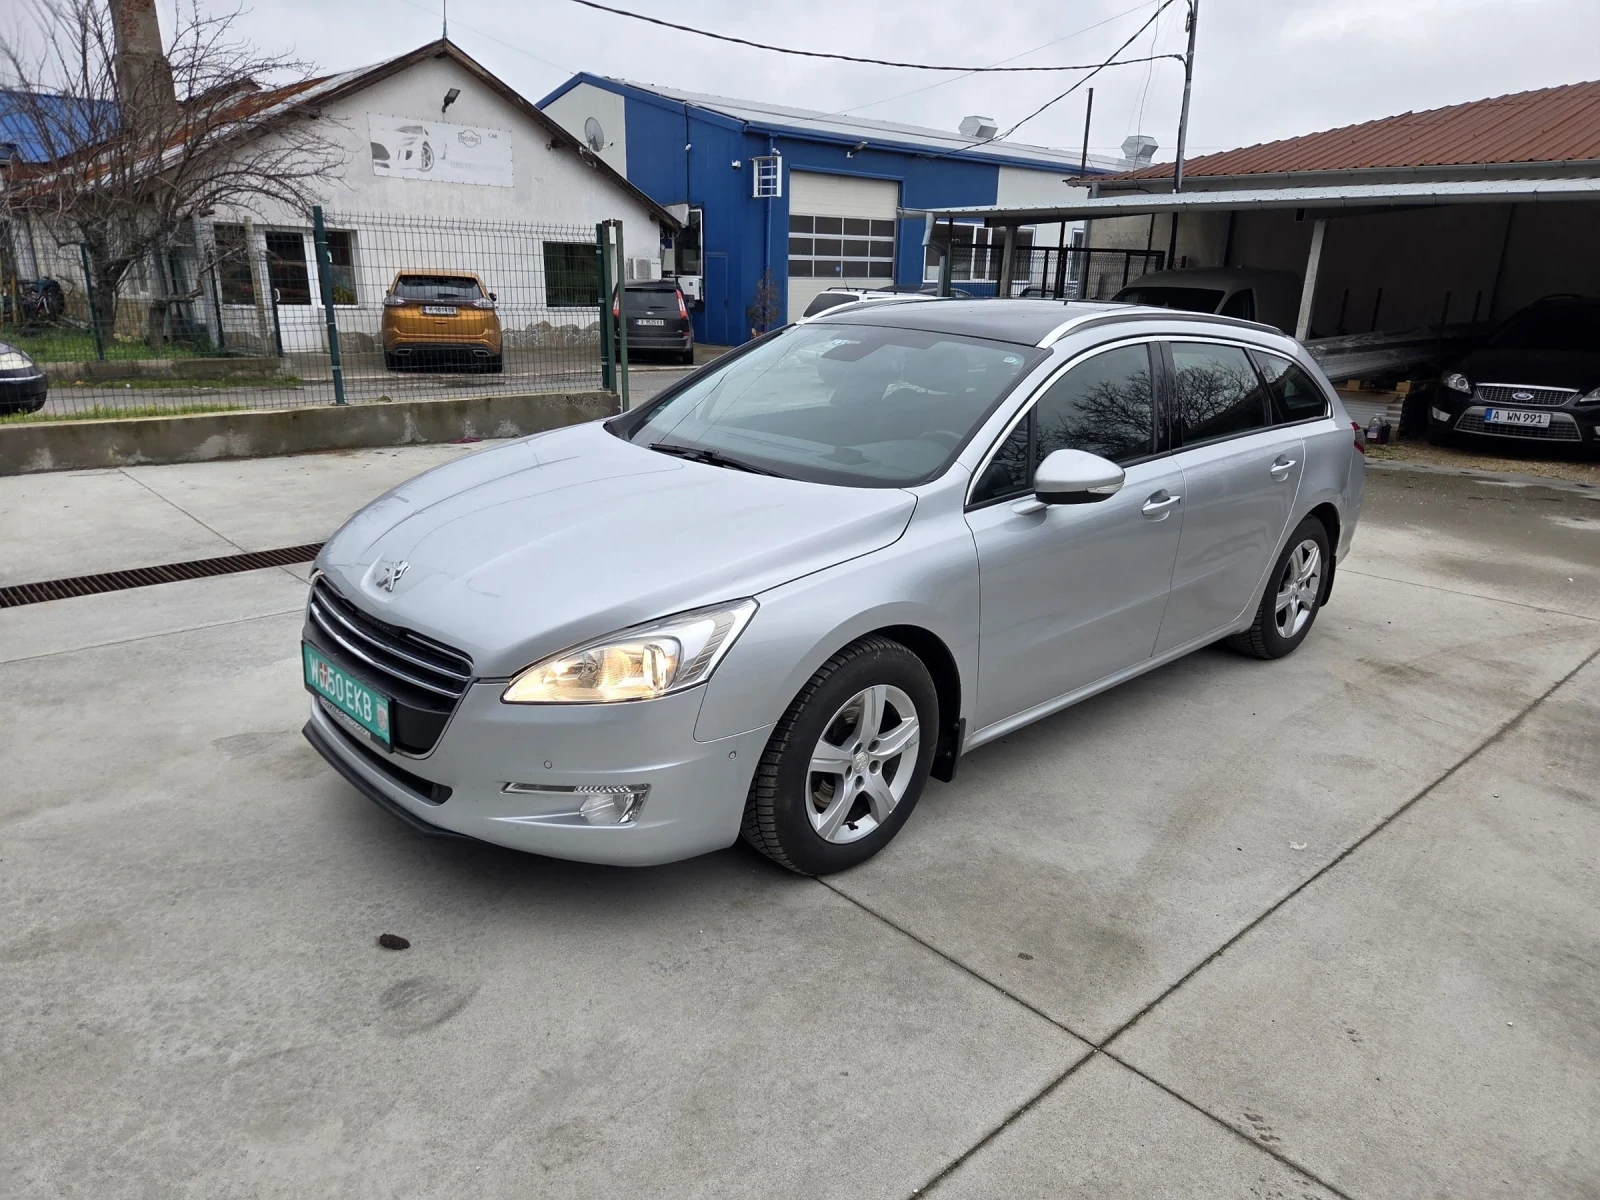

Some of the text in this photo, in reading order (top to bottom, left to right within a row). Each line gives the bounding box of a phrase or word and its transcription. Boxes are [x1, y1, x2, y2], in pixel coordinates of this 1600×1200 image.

[1493, 411, 1543, 423] A WN 991
